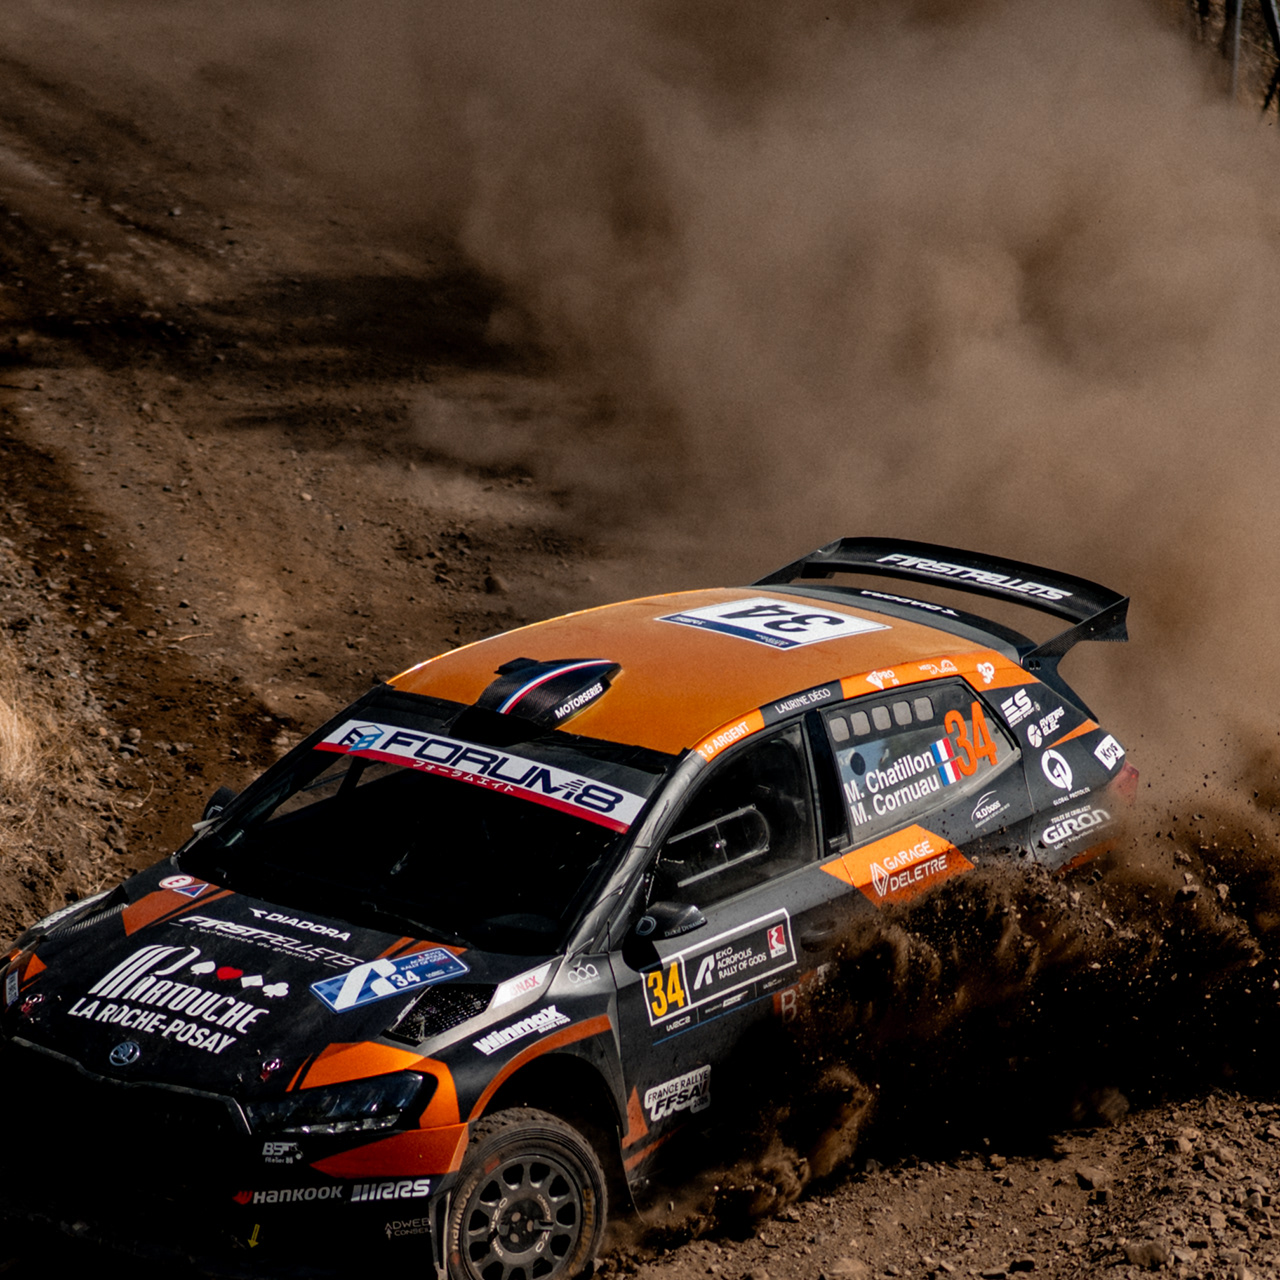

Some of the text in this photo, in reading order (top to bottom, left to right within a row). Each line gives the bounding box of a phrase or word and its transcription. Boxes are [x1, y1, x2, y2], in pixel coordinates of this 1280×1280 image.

[876, 553, 1073, 600] FIRSTPELLETS
[718, 604, 845, 633] 34
[554, 682, 603, 719] MOTORSERIES
[775, 688, 831, 714] LAURINE DÉCO
[713, 721, 750, 749] ARGENT
[944, 700, 998, 776] 34
[379, 730, 624, 813] FORUM8
[413, 759, 515, 792] フォーラムエイト
[843, 751, 936, 804] M. Chatillon
[850, 801, 872, 826] M.
[873, 774, 940, 816] Cornuau
[883, 840, 934, 870] GARAGE
[890, 855, 948, 892] DELETRE
[179, 916, 366, 966] FIRSTPELLETS
[265, 912, 351, 942] DIADORA
[715, 946, 734, 960] EKO
[717, 947, 753, 970] ACROPOLIS
[718, 952, 767, 980] RALLY OF GODS
[390, 970, 421, 987] 34
[647, 961, 685, 1017] 34
[68, 997, 237, 1054] LA ROCHE-POSAY
[648, 1069, 709, 1103] FRANCE RALLYE
[655, 1083, 702, 1116] FFSA
